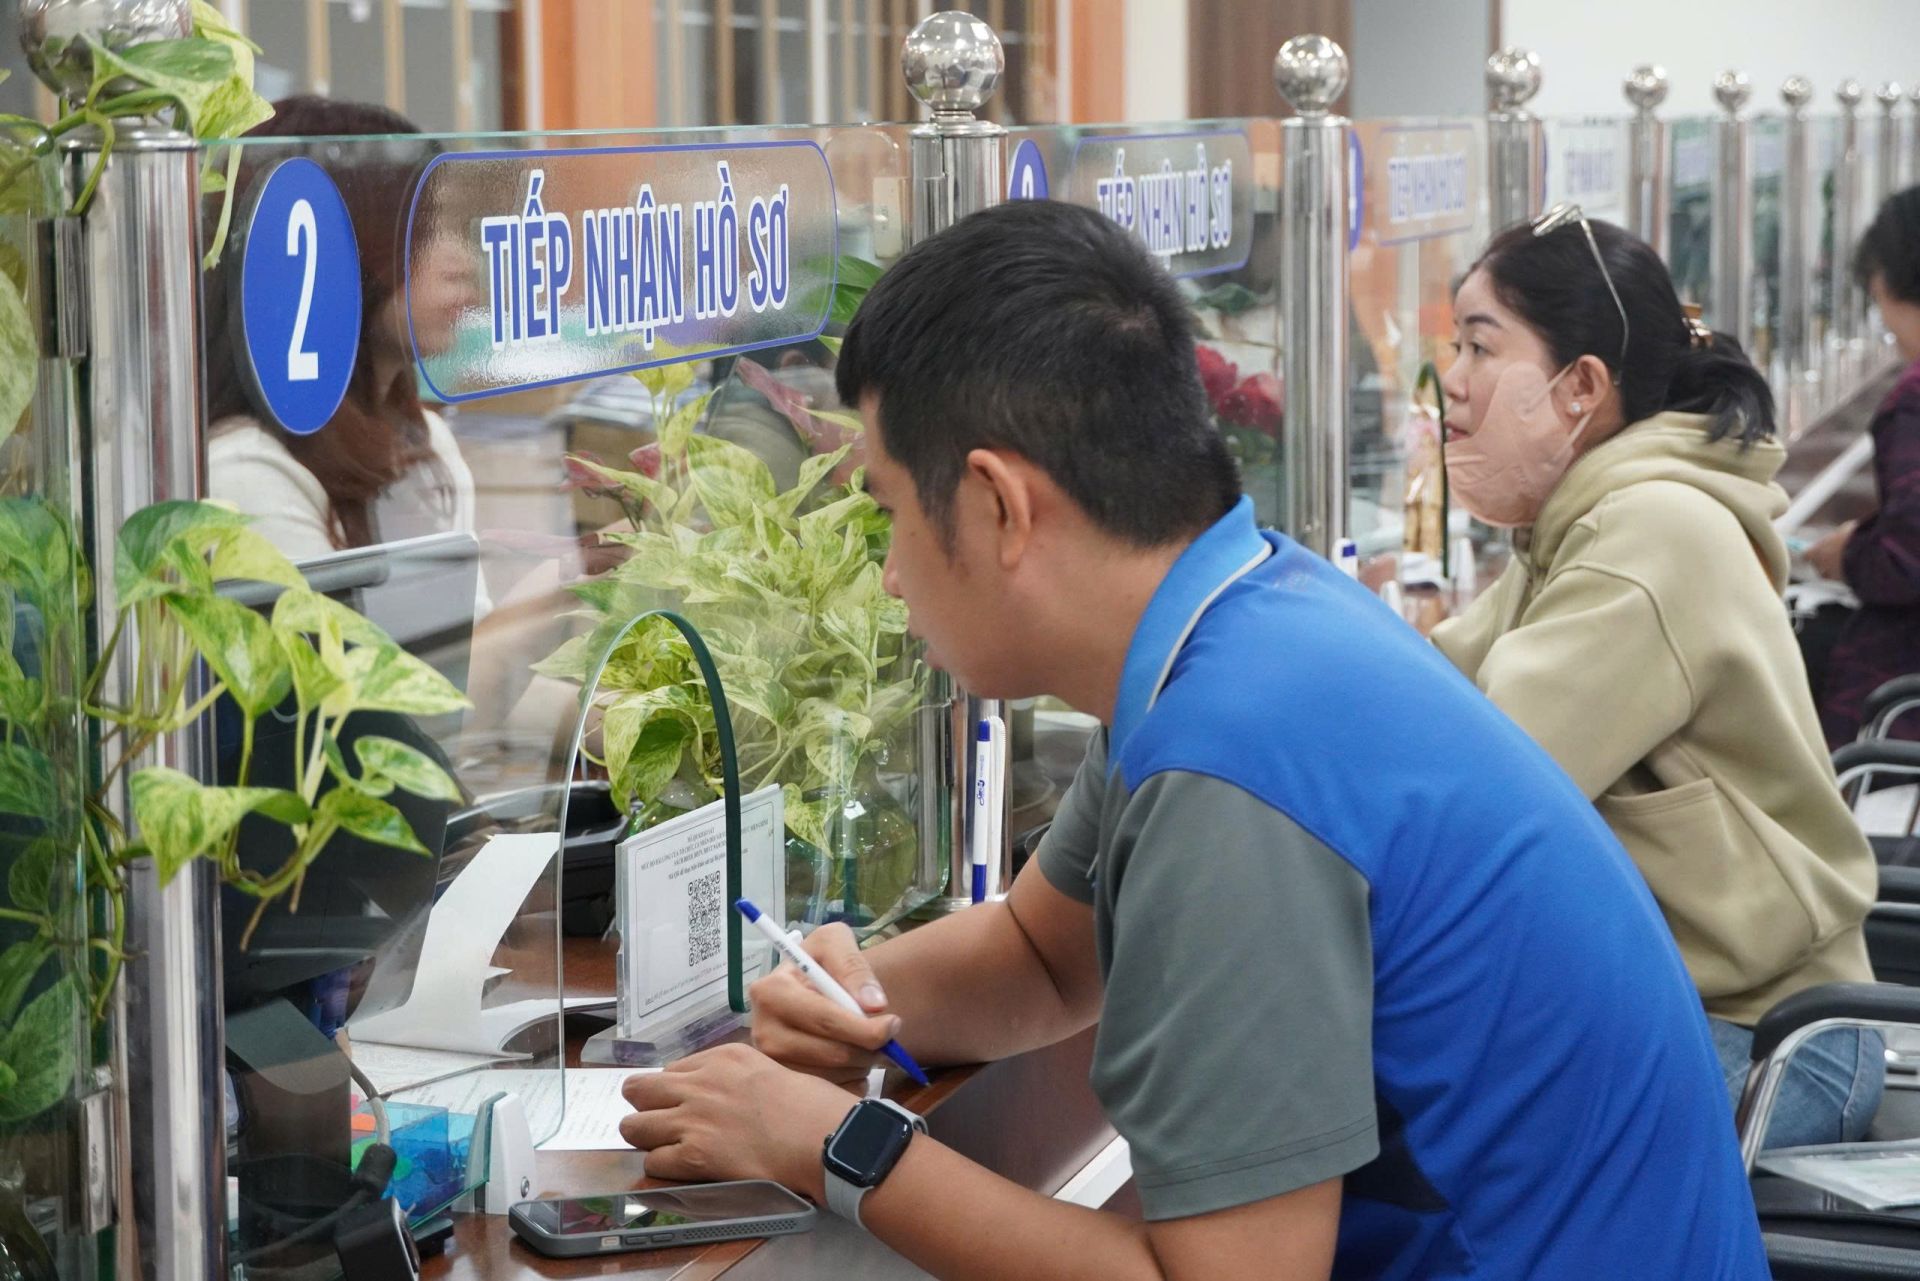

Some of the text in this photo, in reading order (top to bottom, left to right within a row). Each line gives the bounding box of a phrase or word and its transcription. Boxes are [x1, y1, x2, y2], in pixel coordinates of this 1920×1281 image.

[482, 160, 789, 350] TIẾP NHẬN HỒ SƠ
[1186, 142, 1209, 252] HỒ
[1210, 158, 1232, 249] SƠ
[286, 199, 319, 381] 2
